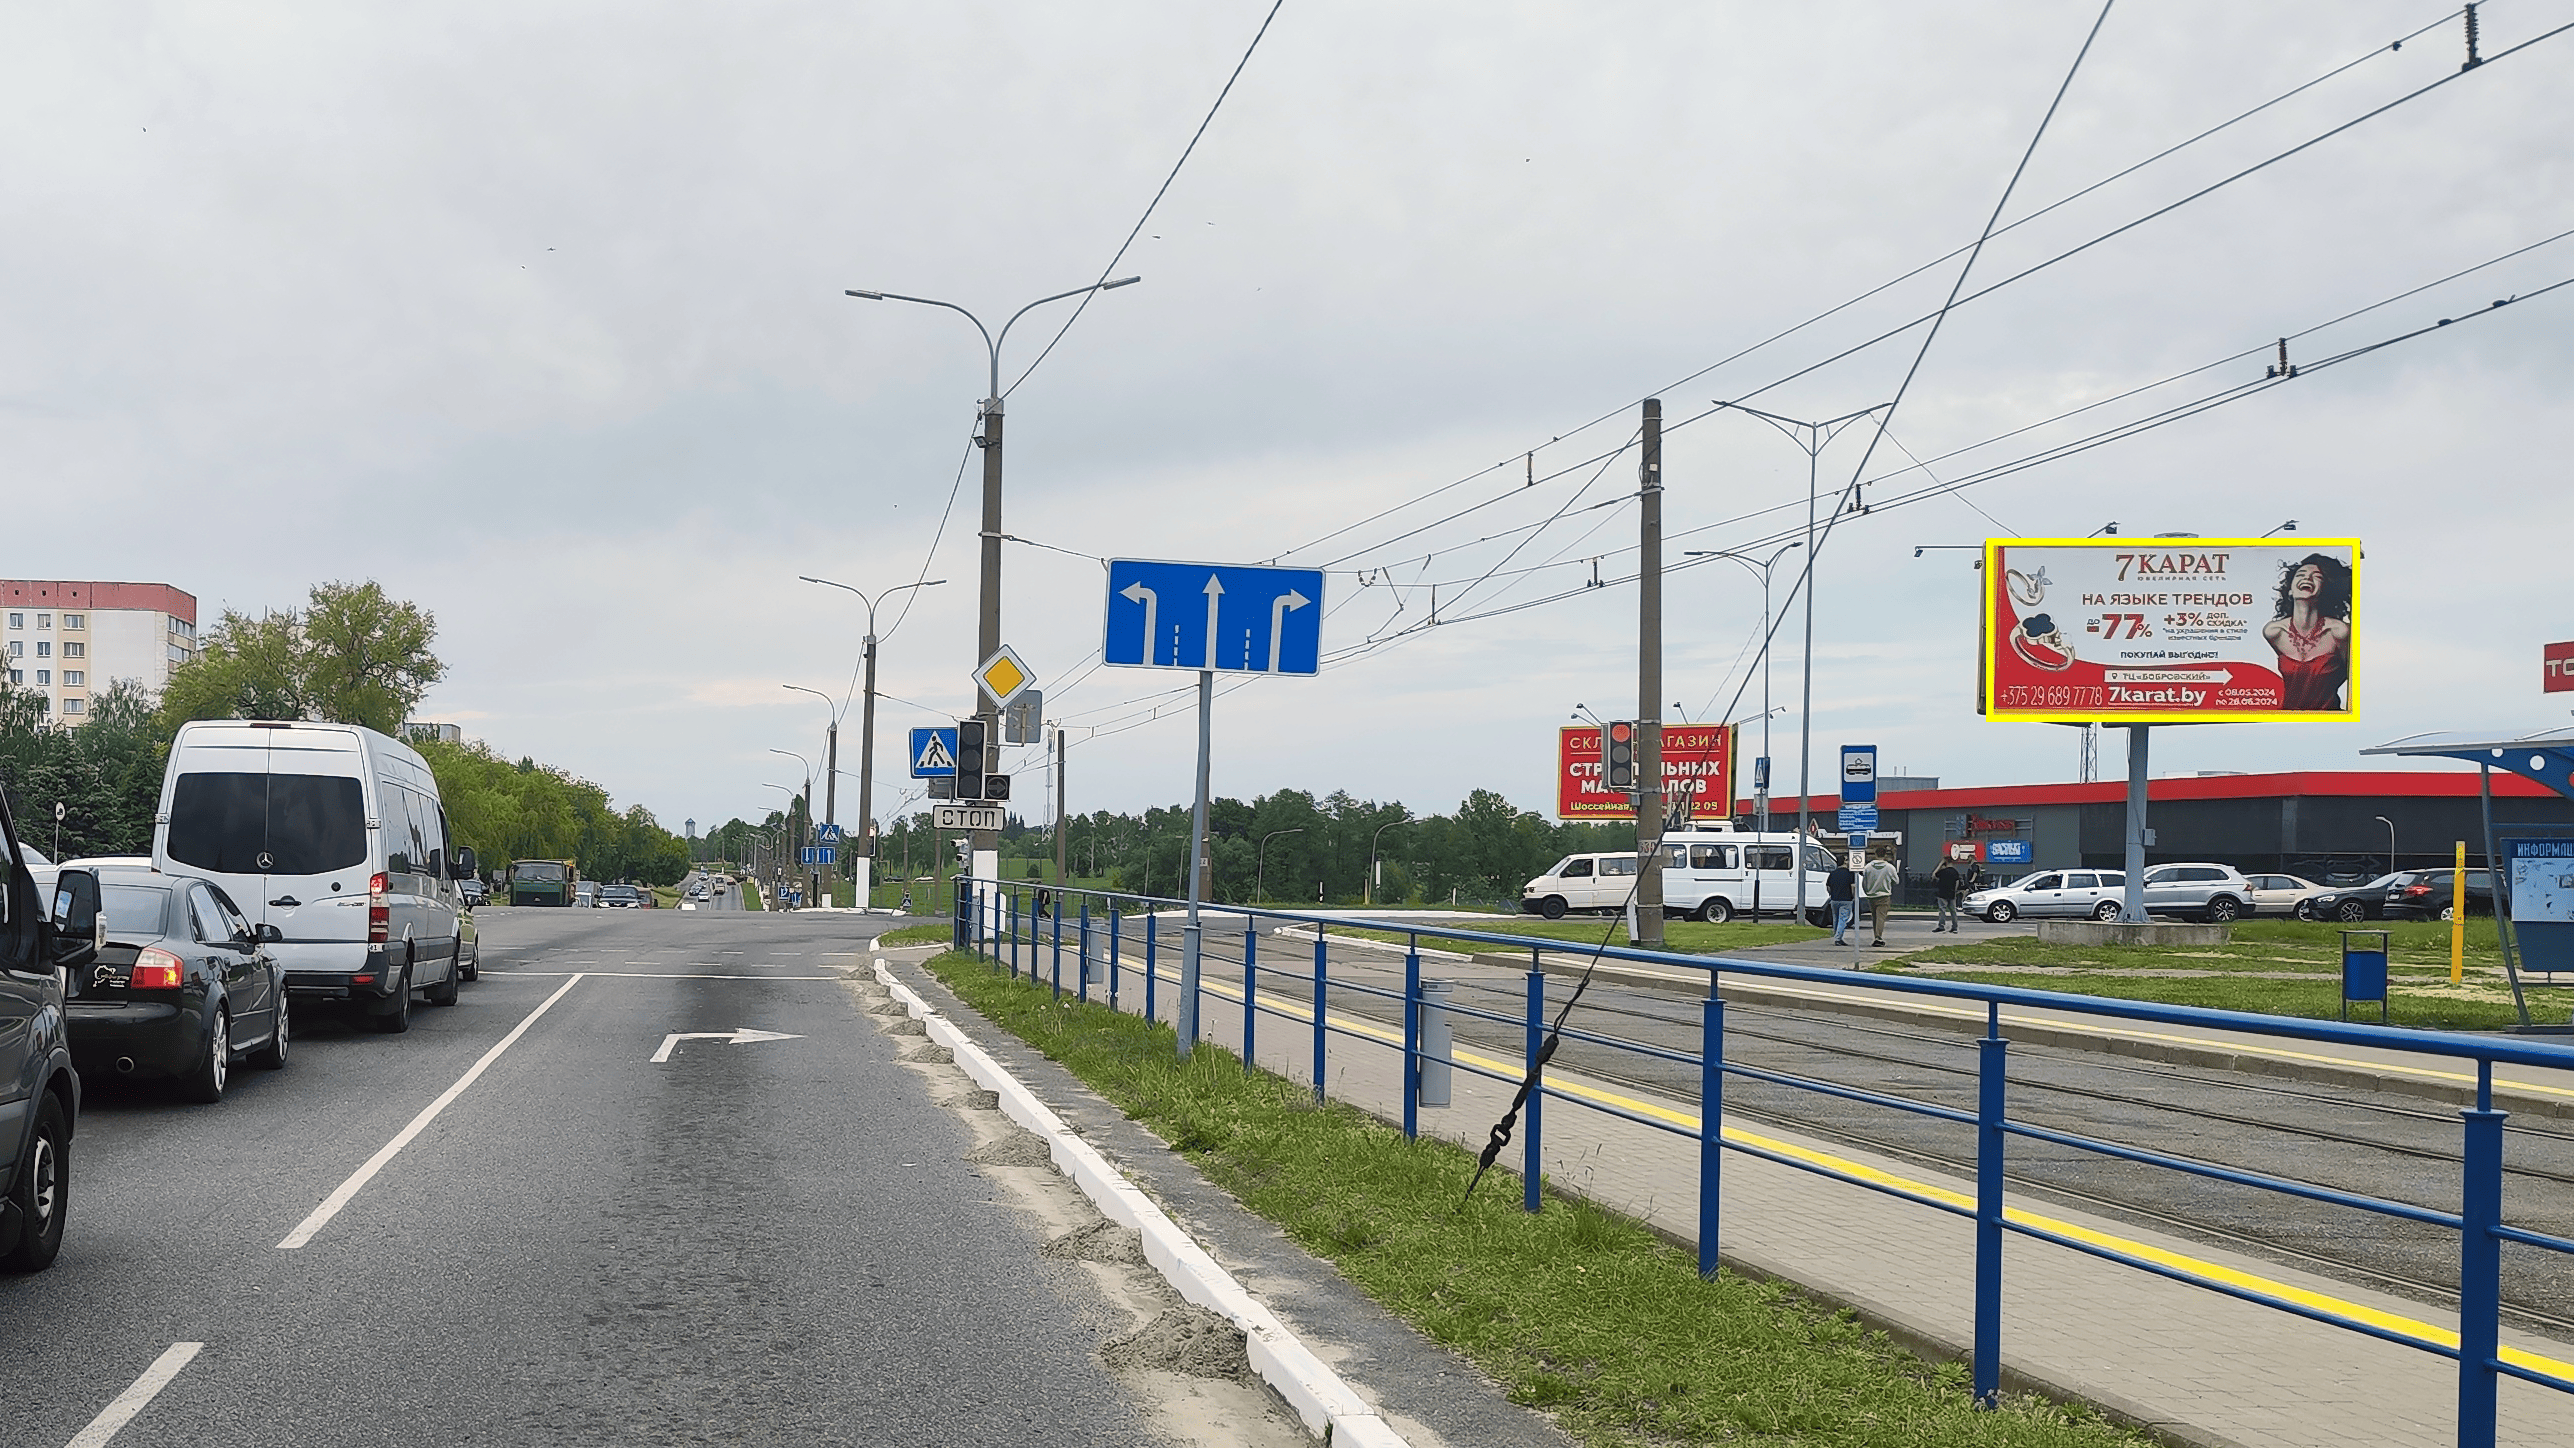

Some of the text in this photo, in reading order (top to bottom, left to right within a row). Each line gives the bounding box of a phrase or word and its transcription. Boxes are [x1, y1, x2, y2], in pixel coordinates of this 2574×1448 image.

[2115, 553, 2230, 581] 7 КАРАТ
[2082, 593, 2253, 607] НА ЯЗЫКЕ ТРЕНДОВ
[2163, 611, 2204, 627] +3%
[2120, 650, 2219, 660] ПОКУПАЙ ВЫГОДНО!
[2000, 685, 2103, 706] +375 29 689 7778
[2107, 686, 2207, 706] 7karat.by
[942, 809, 995, 828] СТОП
